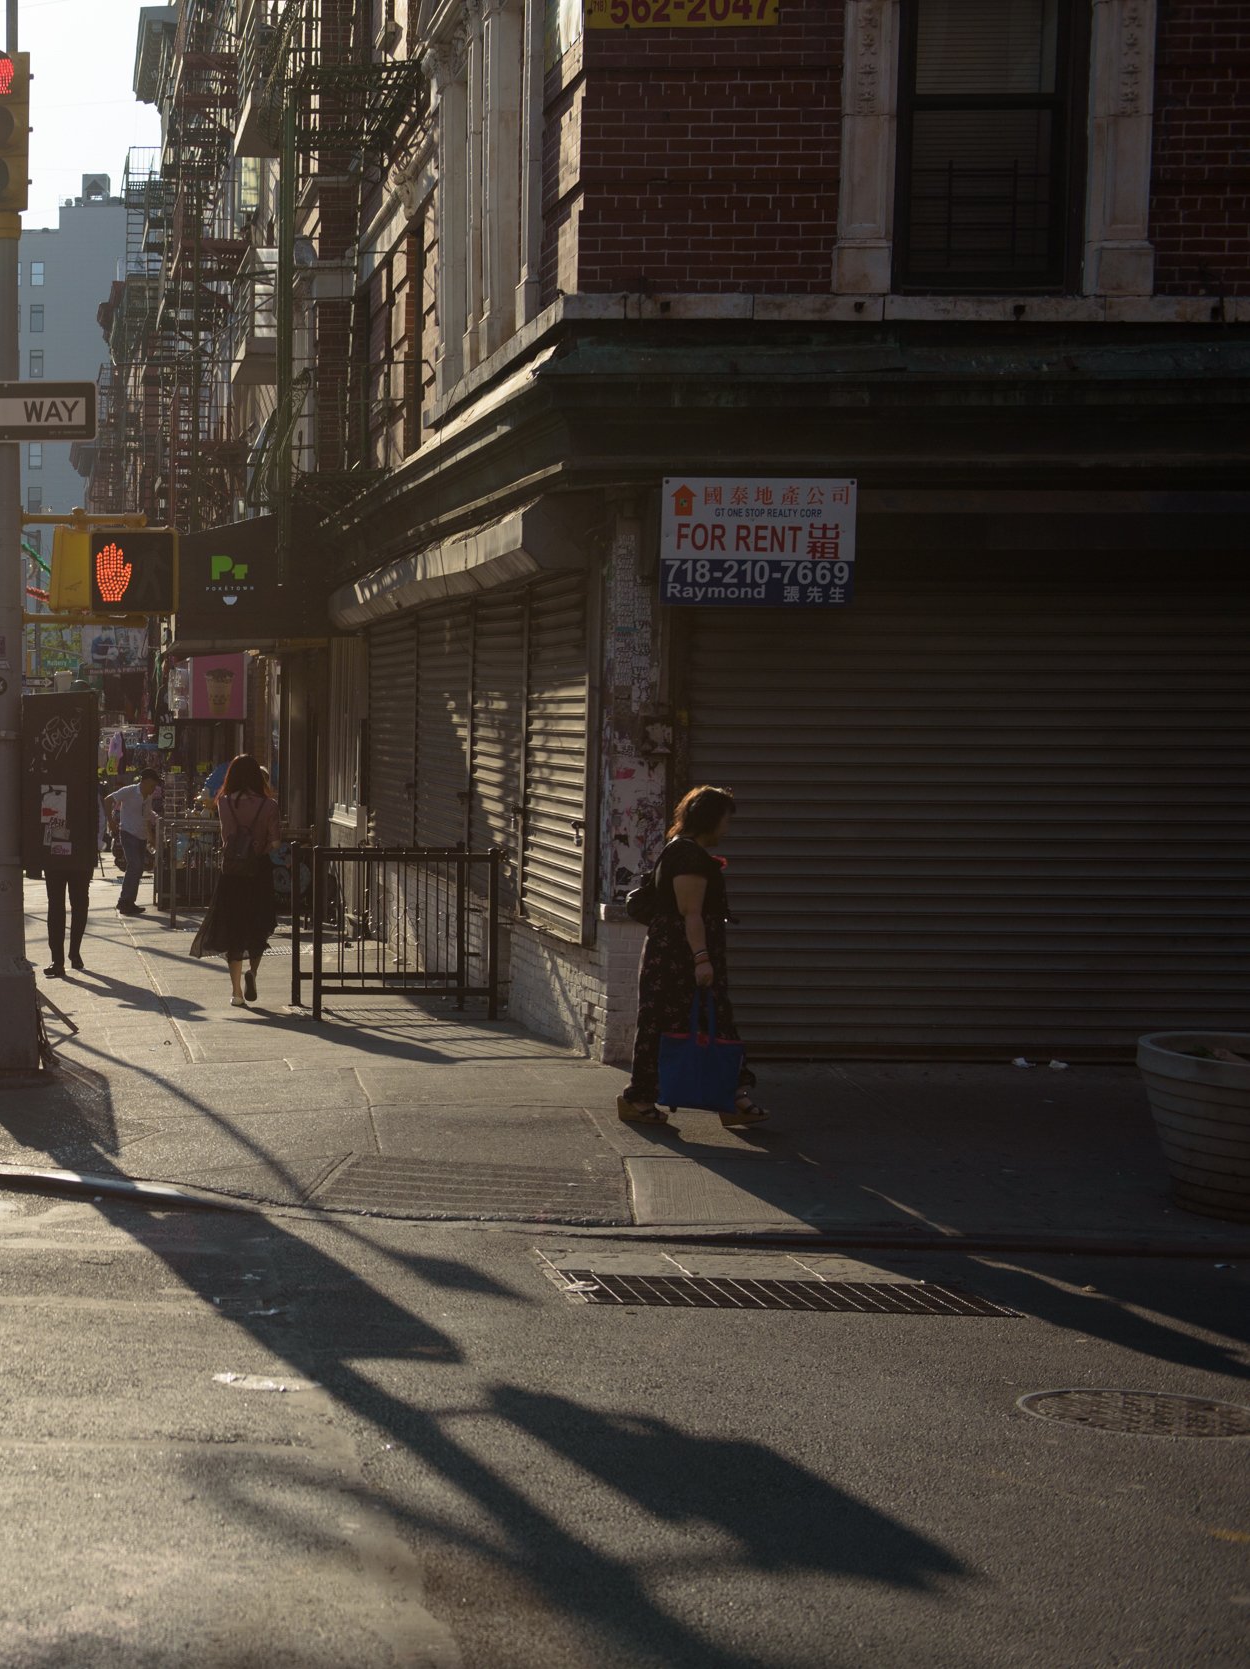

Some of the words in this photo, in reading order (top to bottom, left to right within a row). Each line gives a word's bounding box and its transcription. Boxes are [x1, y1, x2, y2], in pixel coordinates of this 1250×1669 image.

[609, 0, 768, 24] 562-2047
[23, 400, 80, 422] WAY
[704, 485, 851, 506] 國泰地產公司
[714, 507, 726, 518] GT
[728, 508, 743, 518] ONE
[745, 508, 765, 518] STOP
[767, 508, 798, 518] REALTY
[676, 523, 726, 551] FOR
[735, 525, 803, 553] RENT
[665, 560, 850, 585] 718-210-7669
[666, 583, 766, 601] Raymond
[783, 586, 846, 603] 張先生
